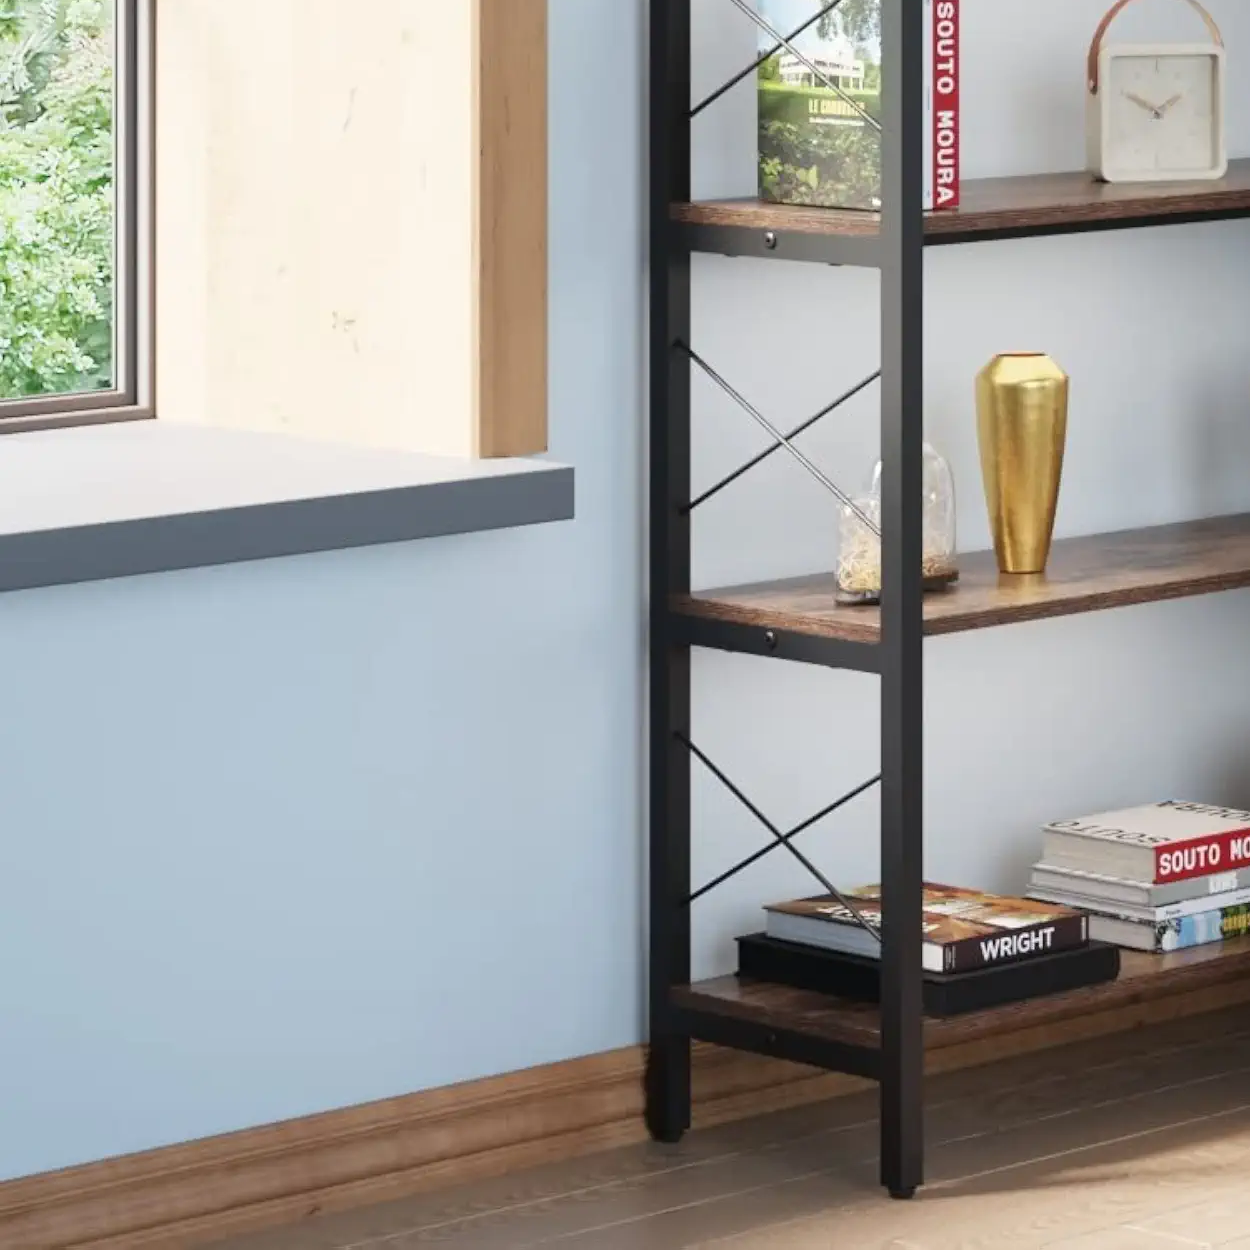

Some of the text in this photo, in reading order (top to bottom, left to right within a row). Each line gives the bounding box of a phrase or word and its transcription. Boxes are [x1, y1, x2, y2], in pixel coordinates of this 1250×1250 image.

[936, 1, 955, 205] SOUTO MOURA
[1158, 843, 1221, 876] SOUTO
[980, 927, 1056, 962] WRIGHT
